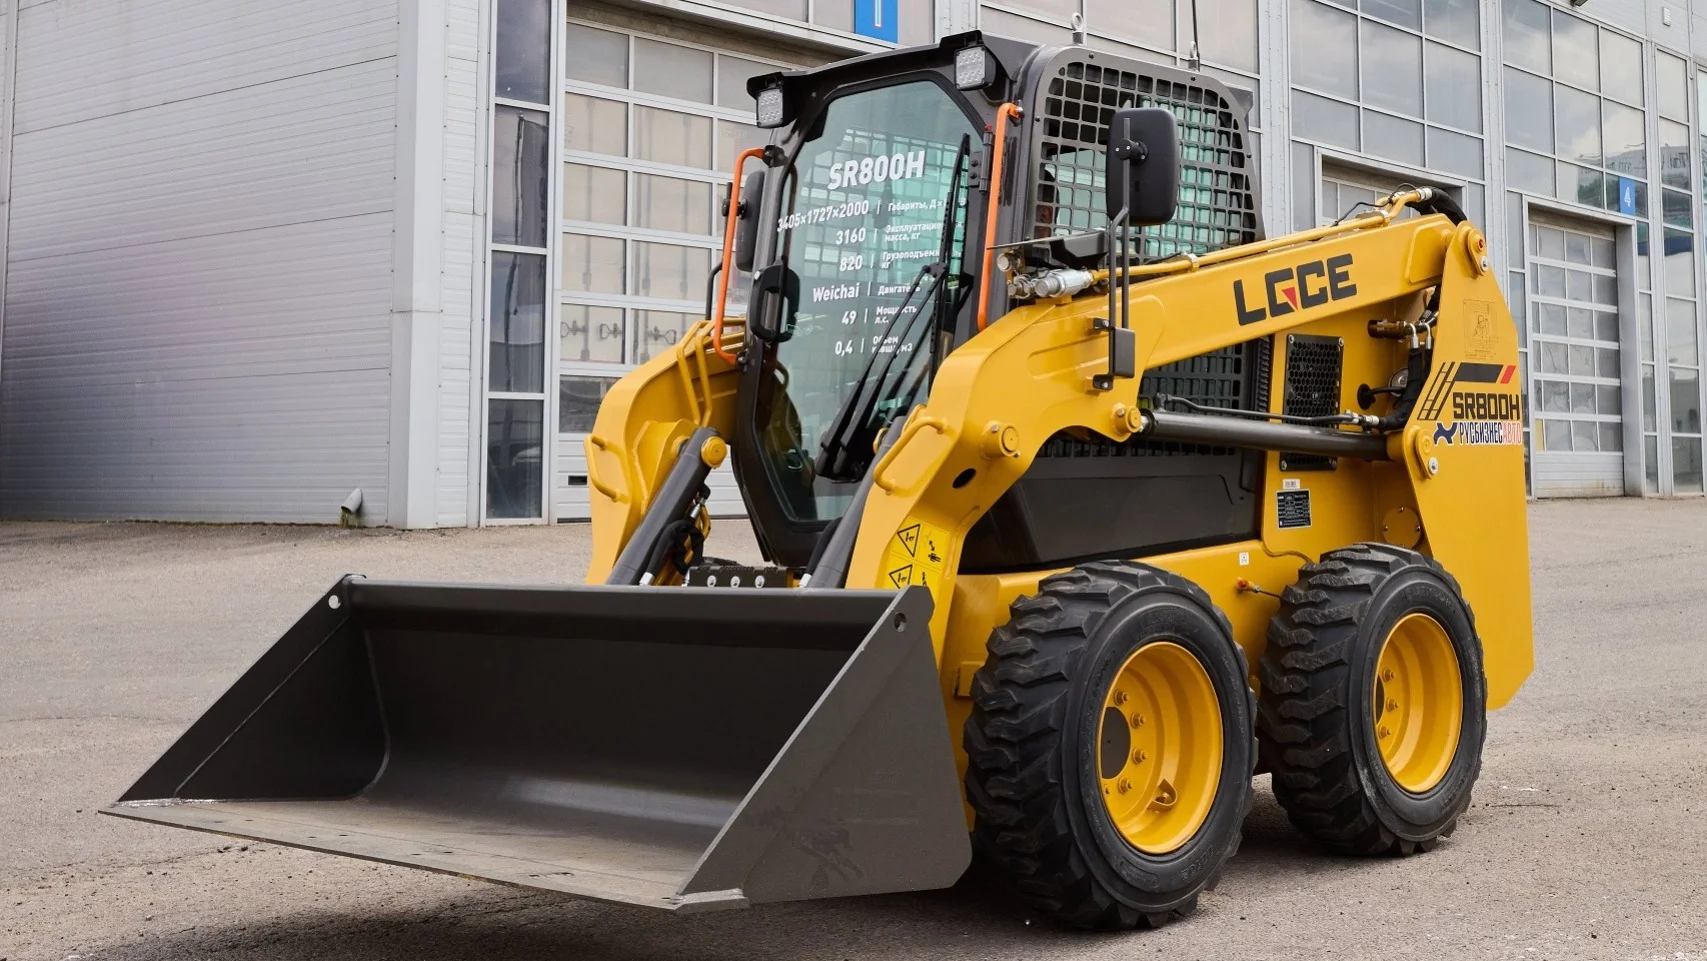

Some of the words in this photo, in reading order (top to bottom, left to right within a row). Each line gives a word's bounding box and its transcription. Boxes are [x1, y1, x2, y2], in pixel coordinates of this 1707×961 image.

[827, 150, 926, 190] SR800H
[1624, 186, 1632, 208] 4
[888, 201, 928, 212] Габариты,
[835, 227, 866, 245] 3160
[884, 233, 910, 242] масса,
[911, 232, 921, 241] кг
[840, 255, 863, 272] 820
[881, 261, 891, 269] кг
[812, 282, 860, 302] Weichai
[877, 284, 921, 296] Двигатеь
[1233, 253, 1358, 326] LGCE
[841, 310, 857, 325] 49
[835, 340, 853, 357] 0,4
[1452, 392, 1521, 420] SR800H
